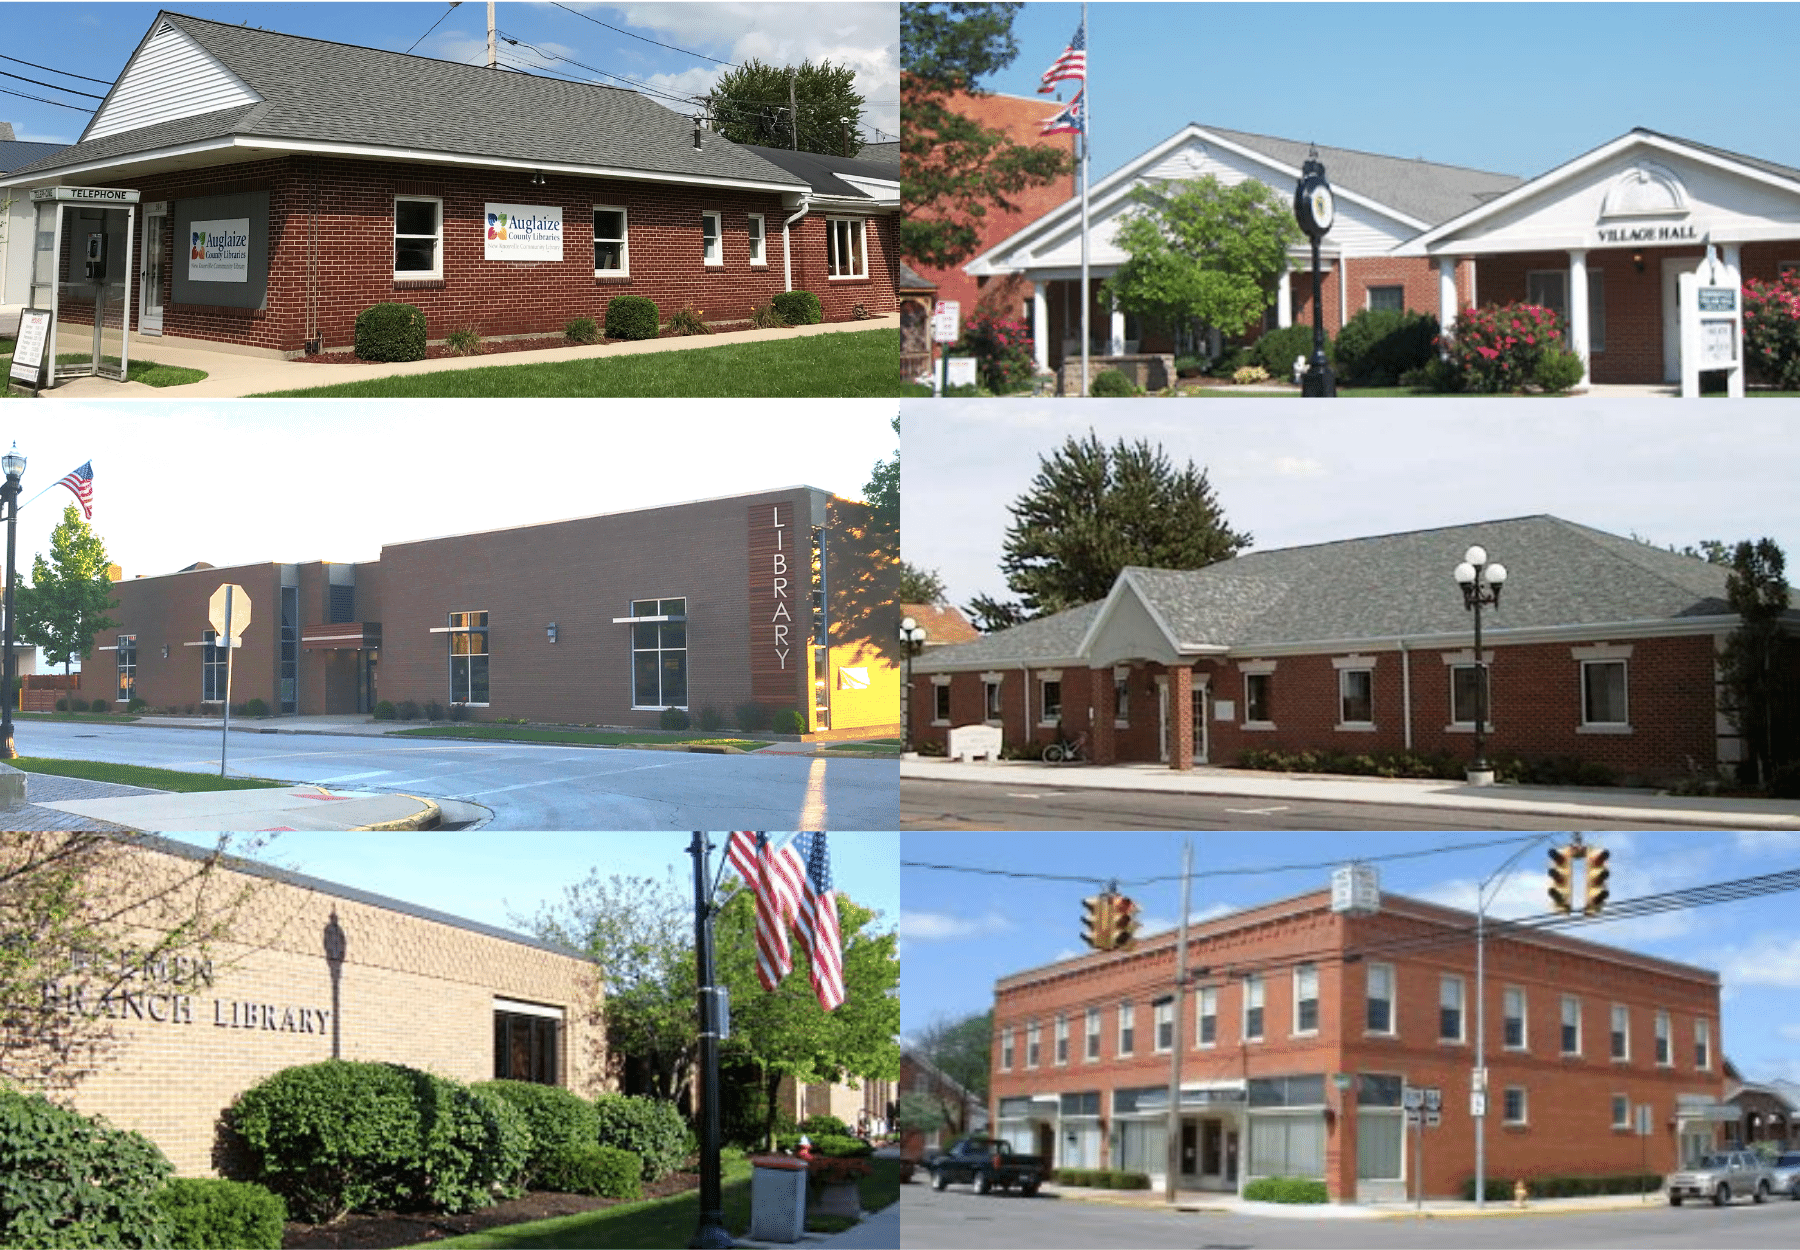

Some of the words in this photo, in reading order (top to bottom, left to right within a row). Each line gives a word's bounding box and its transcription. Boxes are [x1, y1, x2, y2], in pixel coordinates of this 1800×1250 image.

[71, 189, 127, 200] TELEPHONE
[508, 215, 560, 234] Auglaize
[206, 230, 247, 252] Auglaize
[508, 232, 532, 242] County
[532, 232, 561, 241] Libraries
[1598, 229, 1656, 241] VILLAGE
[1658, 226, 1697, 240] HALL
[205, 250, 223, 261] County
[223, 250, 246, 259] Libraries
[772, 507, 791, 670] LIBRARY
[213, 999, 330, 1035] LIBRARY
